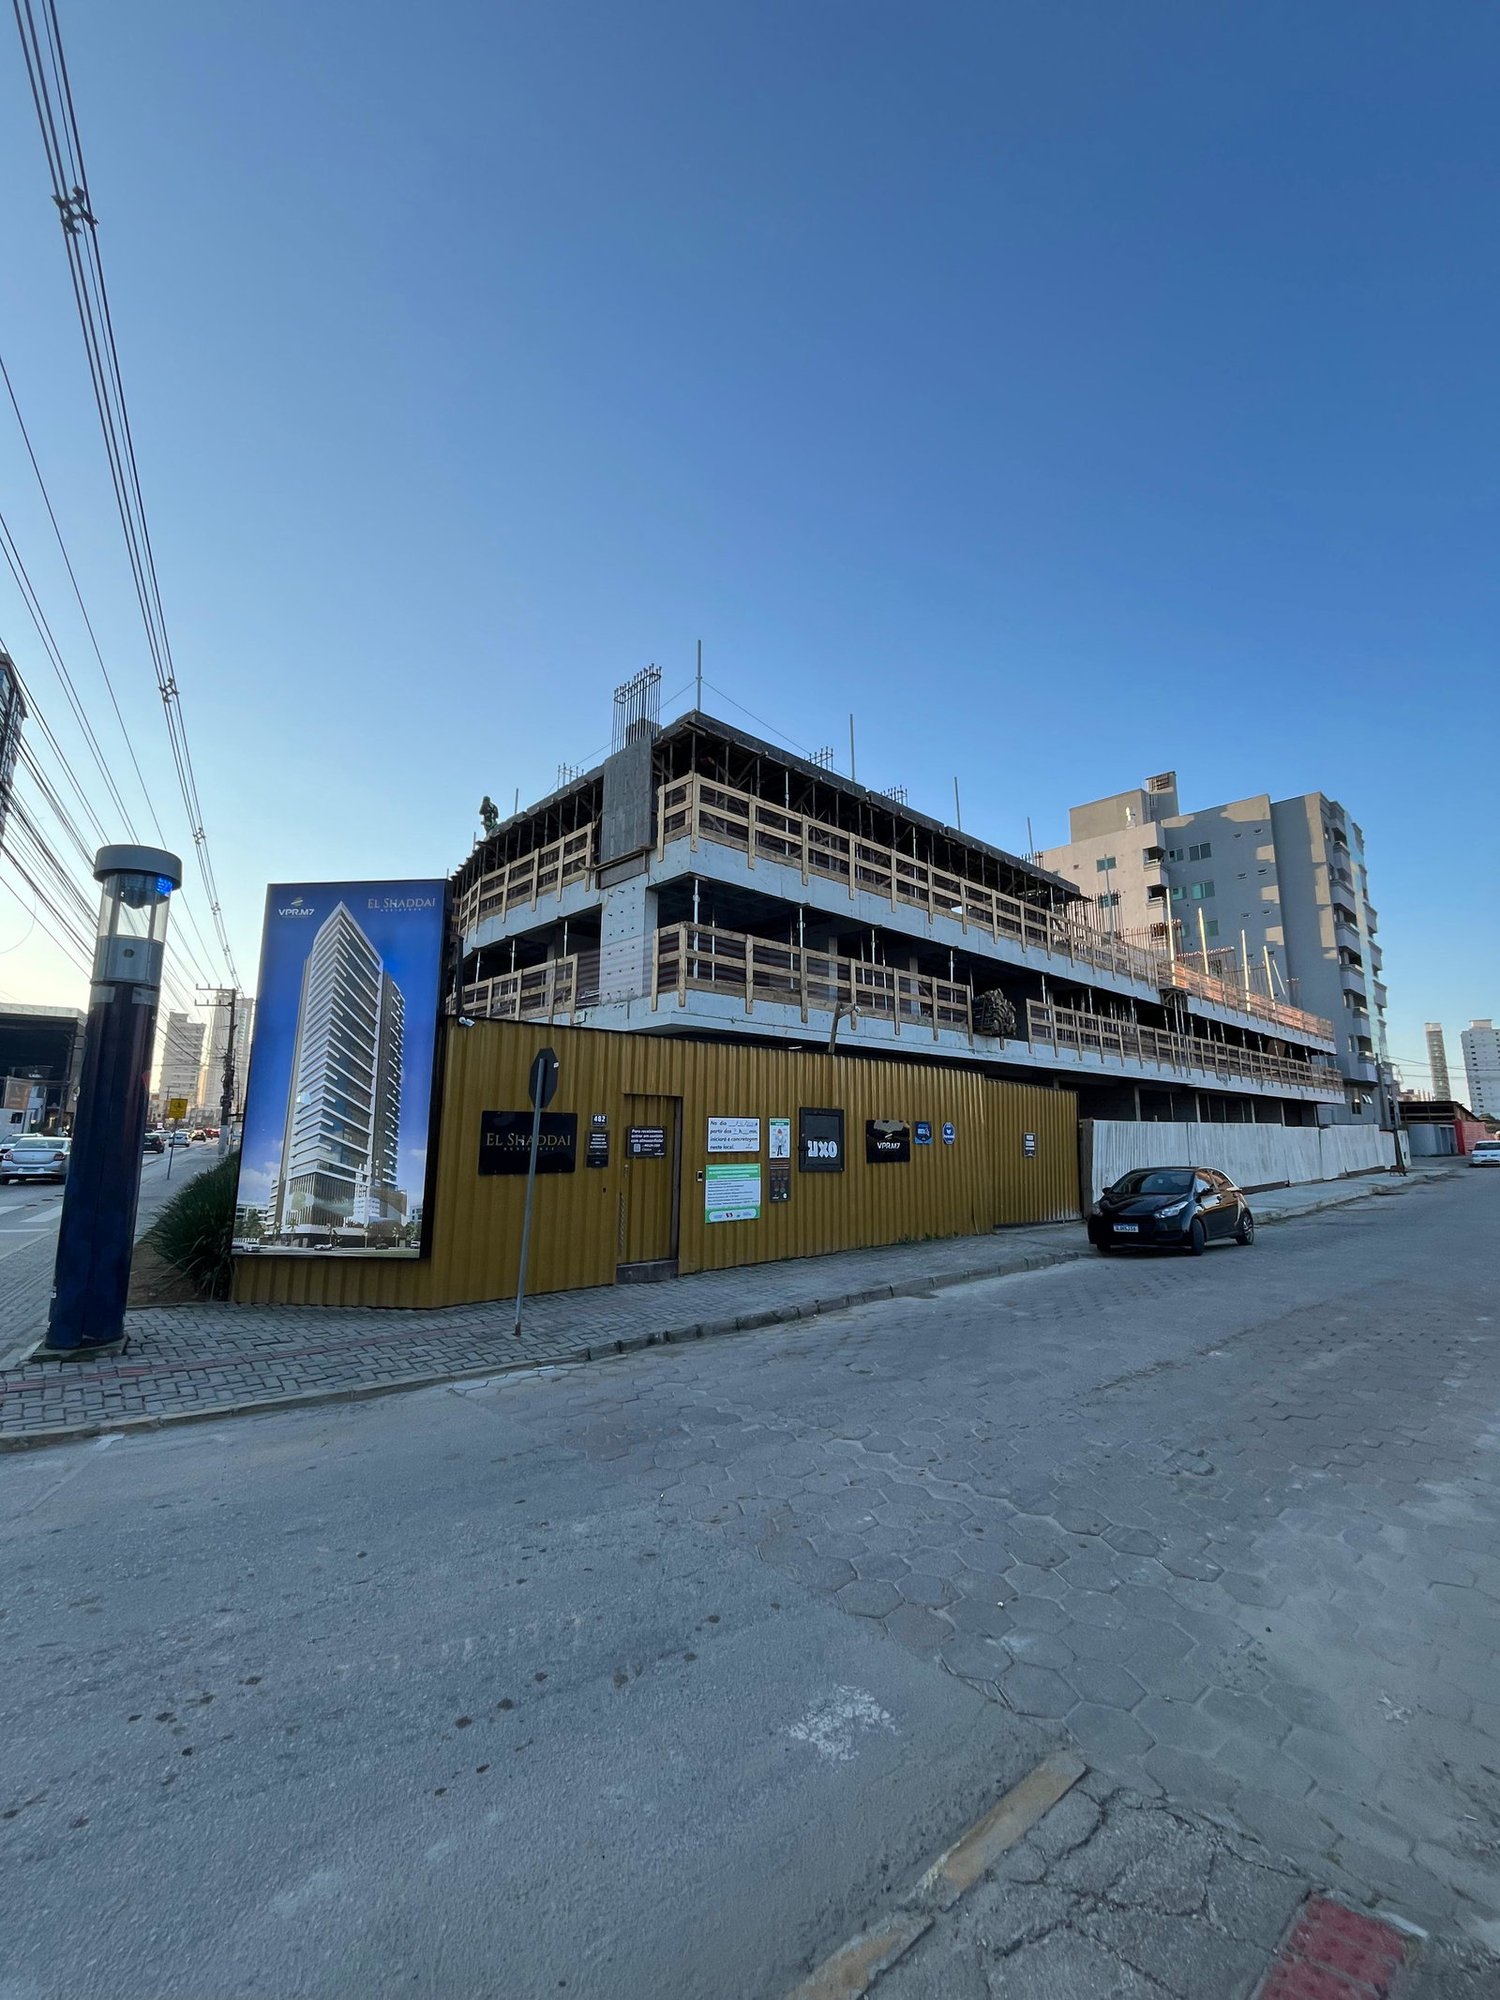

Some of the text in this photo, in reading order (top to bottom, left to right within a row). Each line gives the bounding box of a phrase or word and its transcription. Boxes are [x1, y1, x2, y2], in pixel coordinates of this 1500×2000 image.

[367, 898, 436, 909] EL SHADDAI
[486, 1133, 503, 1146] EL
